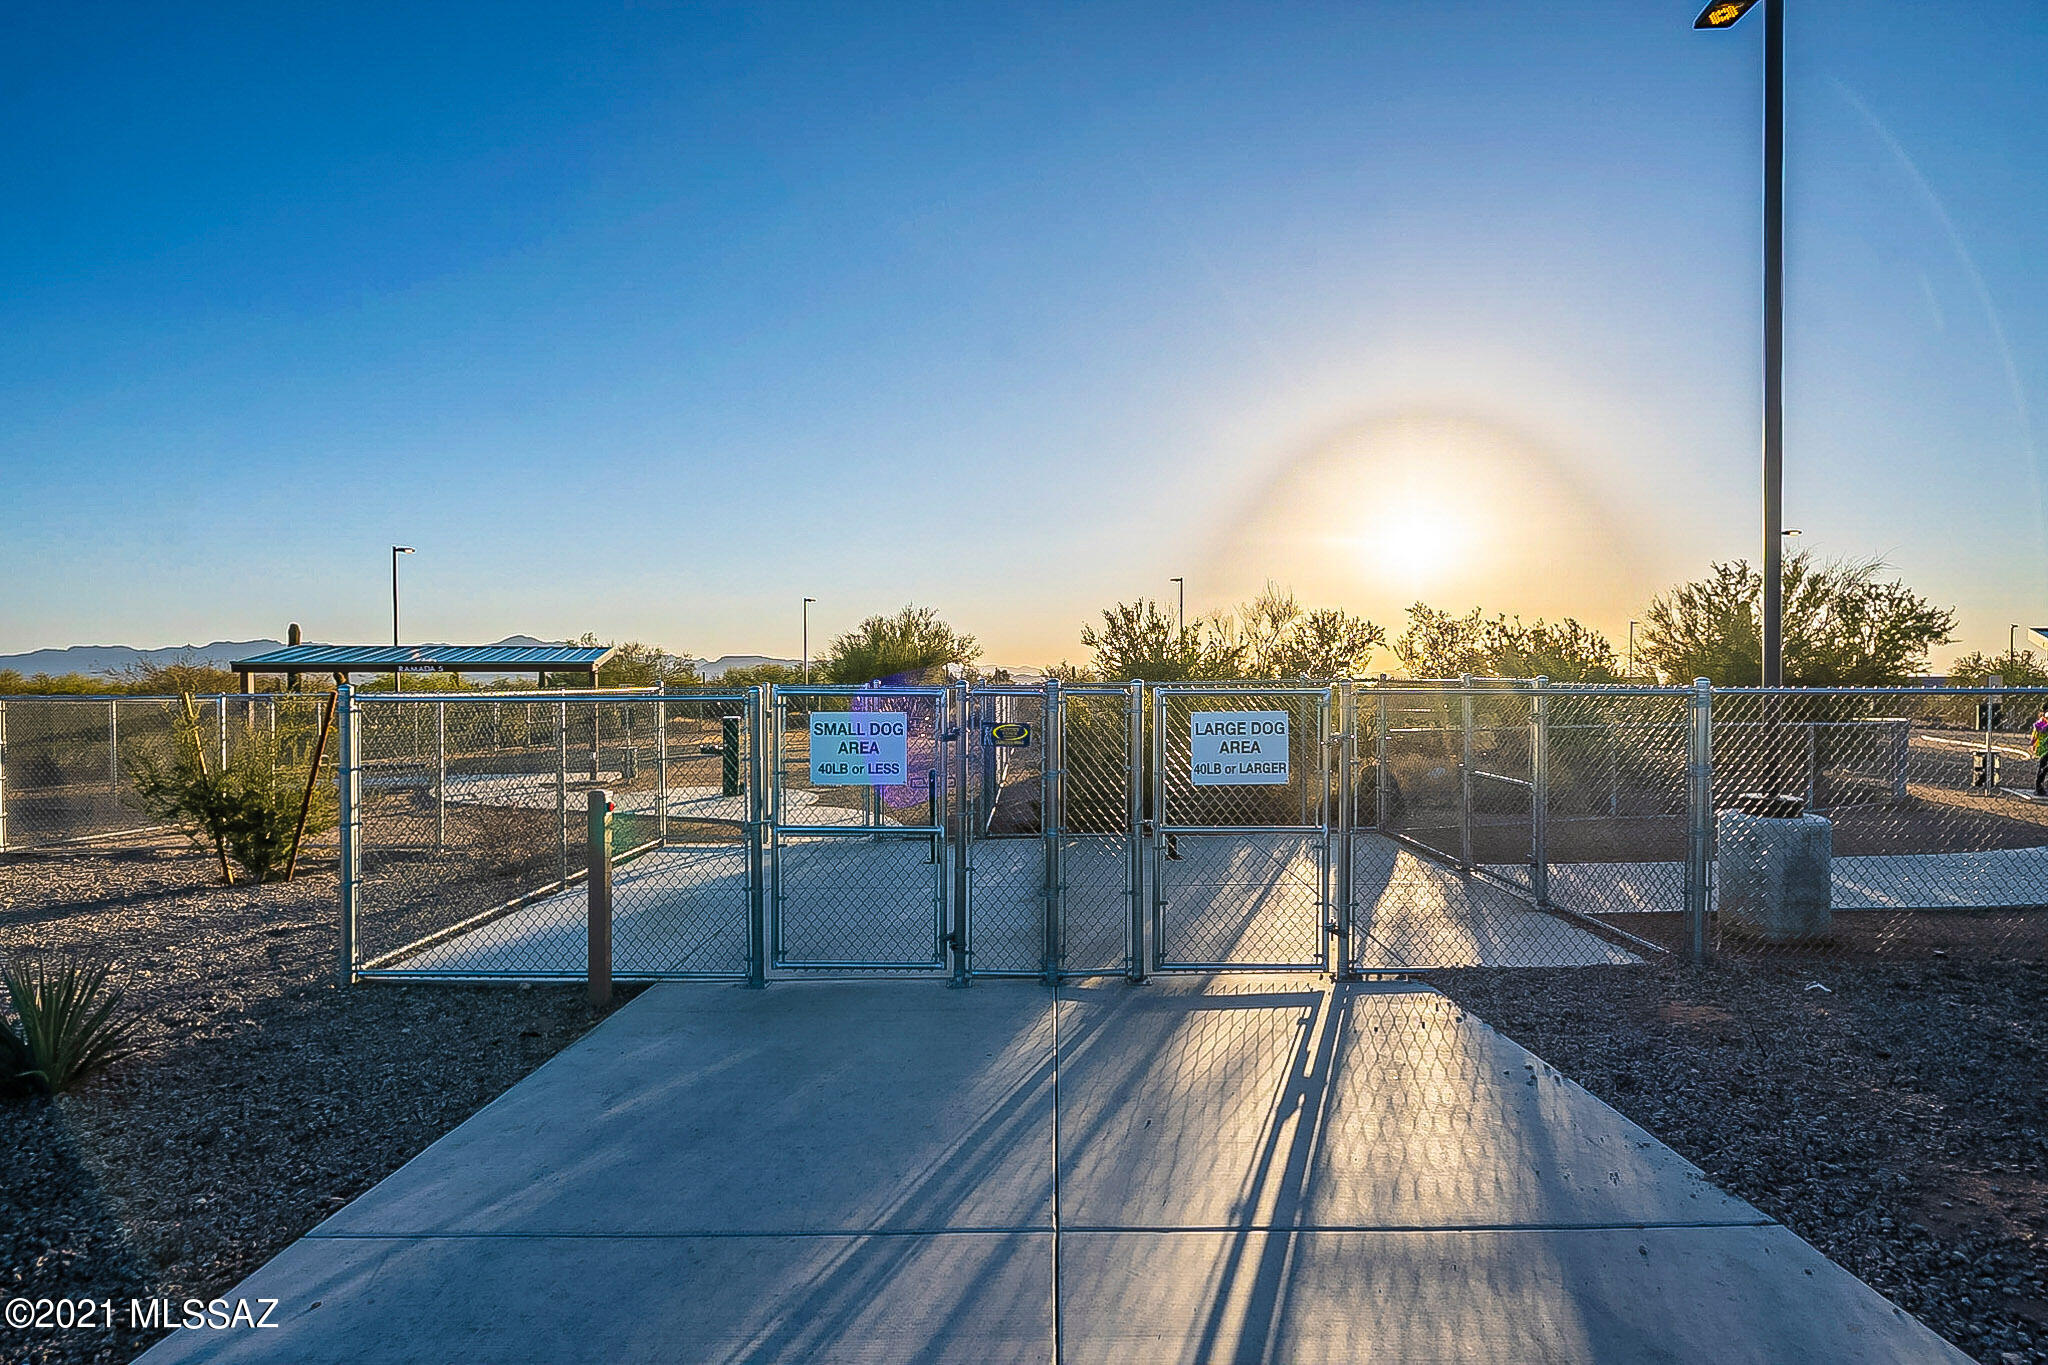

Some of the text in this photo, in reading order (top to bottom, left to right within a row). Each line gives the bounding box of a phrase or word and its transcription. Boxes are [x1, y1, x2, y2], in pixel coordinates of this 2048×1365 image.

[813, 722, 904, 736] SMALL DOG
[1195, 721, 1286, 736] LARGE DOG
[837, 741, 880, 755] AREA
[1219, 740, 1262, 754] AREA
[817, 763, 900, 775] 40LB or LESS
[1193, 762, 1287, 775] 40LB or LARGER
